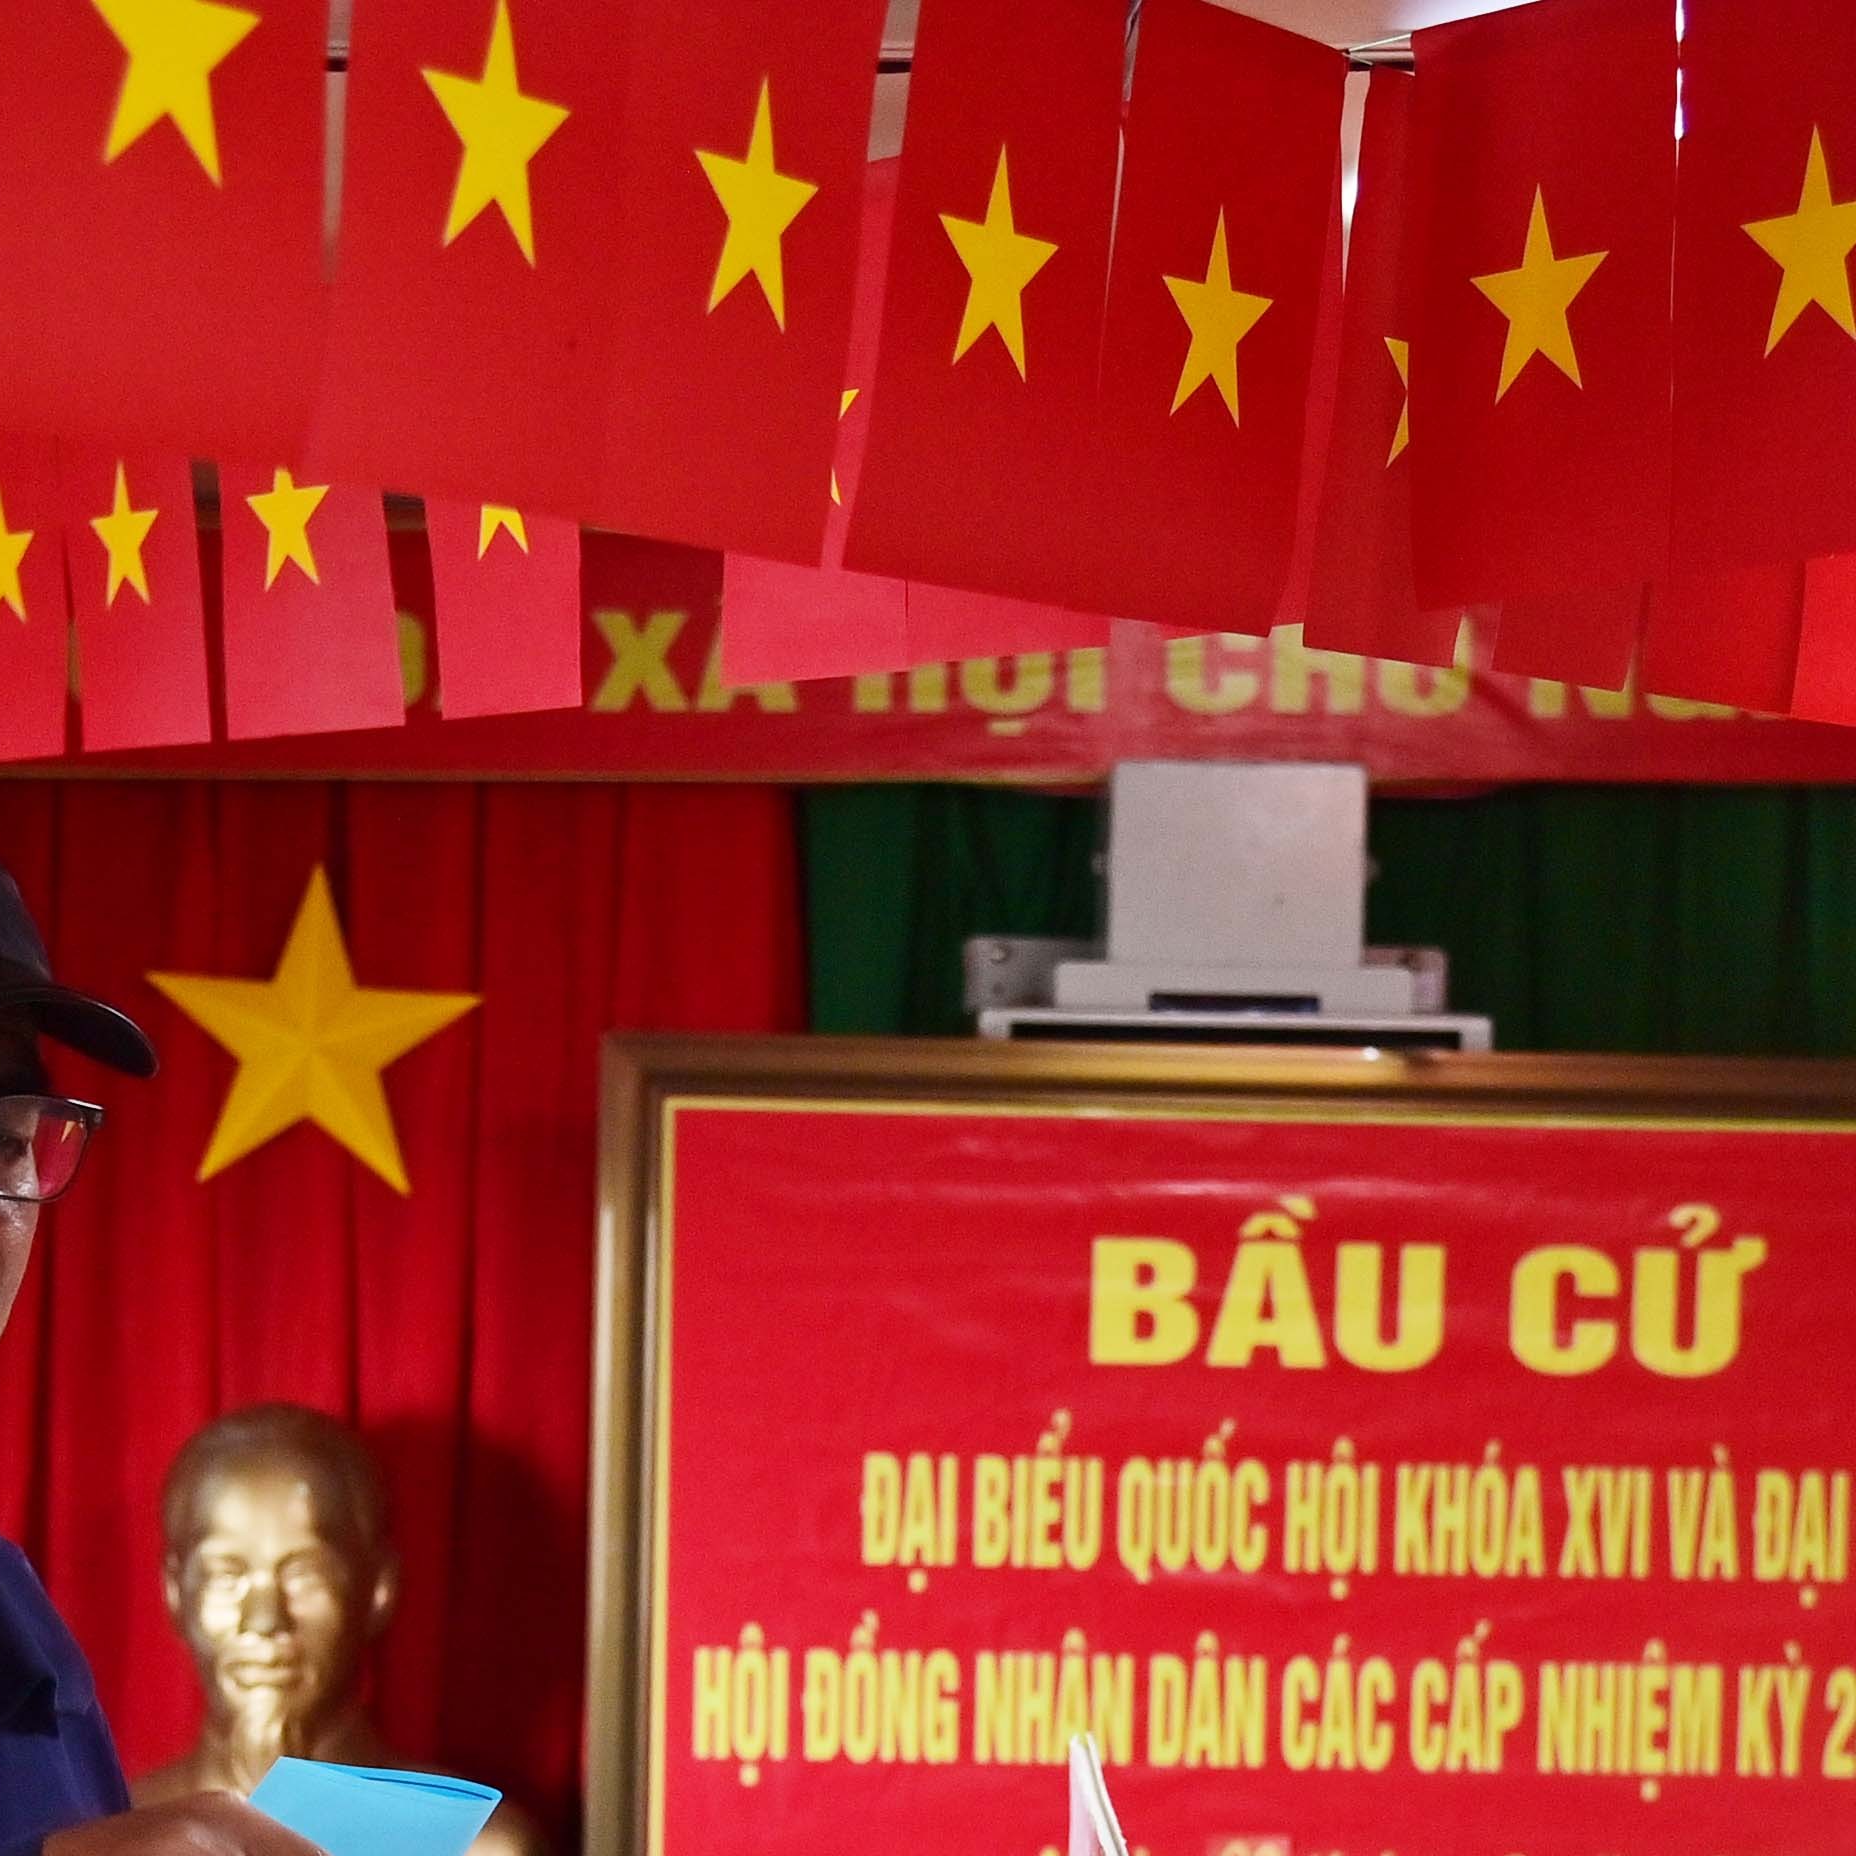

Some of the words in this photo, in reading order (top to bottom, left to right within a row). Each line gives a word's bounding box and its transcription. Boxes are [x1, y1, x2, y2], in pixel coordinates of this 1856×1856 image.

[1089, 1196, 1447, 1373] BẦU
[1510, 1203, 1769, 1378] CỬ
[860, 1450, 961, 1594] ĐẠI
[971, 1408, 1105, 1571] BIỂU
[1117, 1416, 1272, 1584] QUỐC
[1283, 1437, 1381, 1600] HỘI
[1394, 1439, 1547, 1578] KHÓA
[1559, 1466, 1654, 1579] XVI
[1667, 1445, 1741, 1581] VÀ
[1752, 1468, 1852, 1609] ĐẠI
[691, 1621, 792, 1788] HỘI
[973, 1627, 1137, 1767] NHÂN
[1147, 1630, 1270, 1770] DÂN
[1280, 1633, 1397, 1773] CÁC
[1409, 1617, 1526, 1774] CẤP
[1536, 1637, 1726, 1801] NHIỆM
[1736, 1640, 1813, 1778] KỲ
